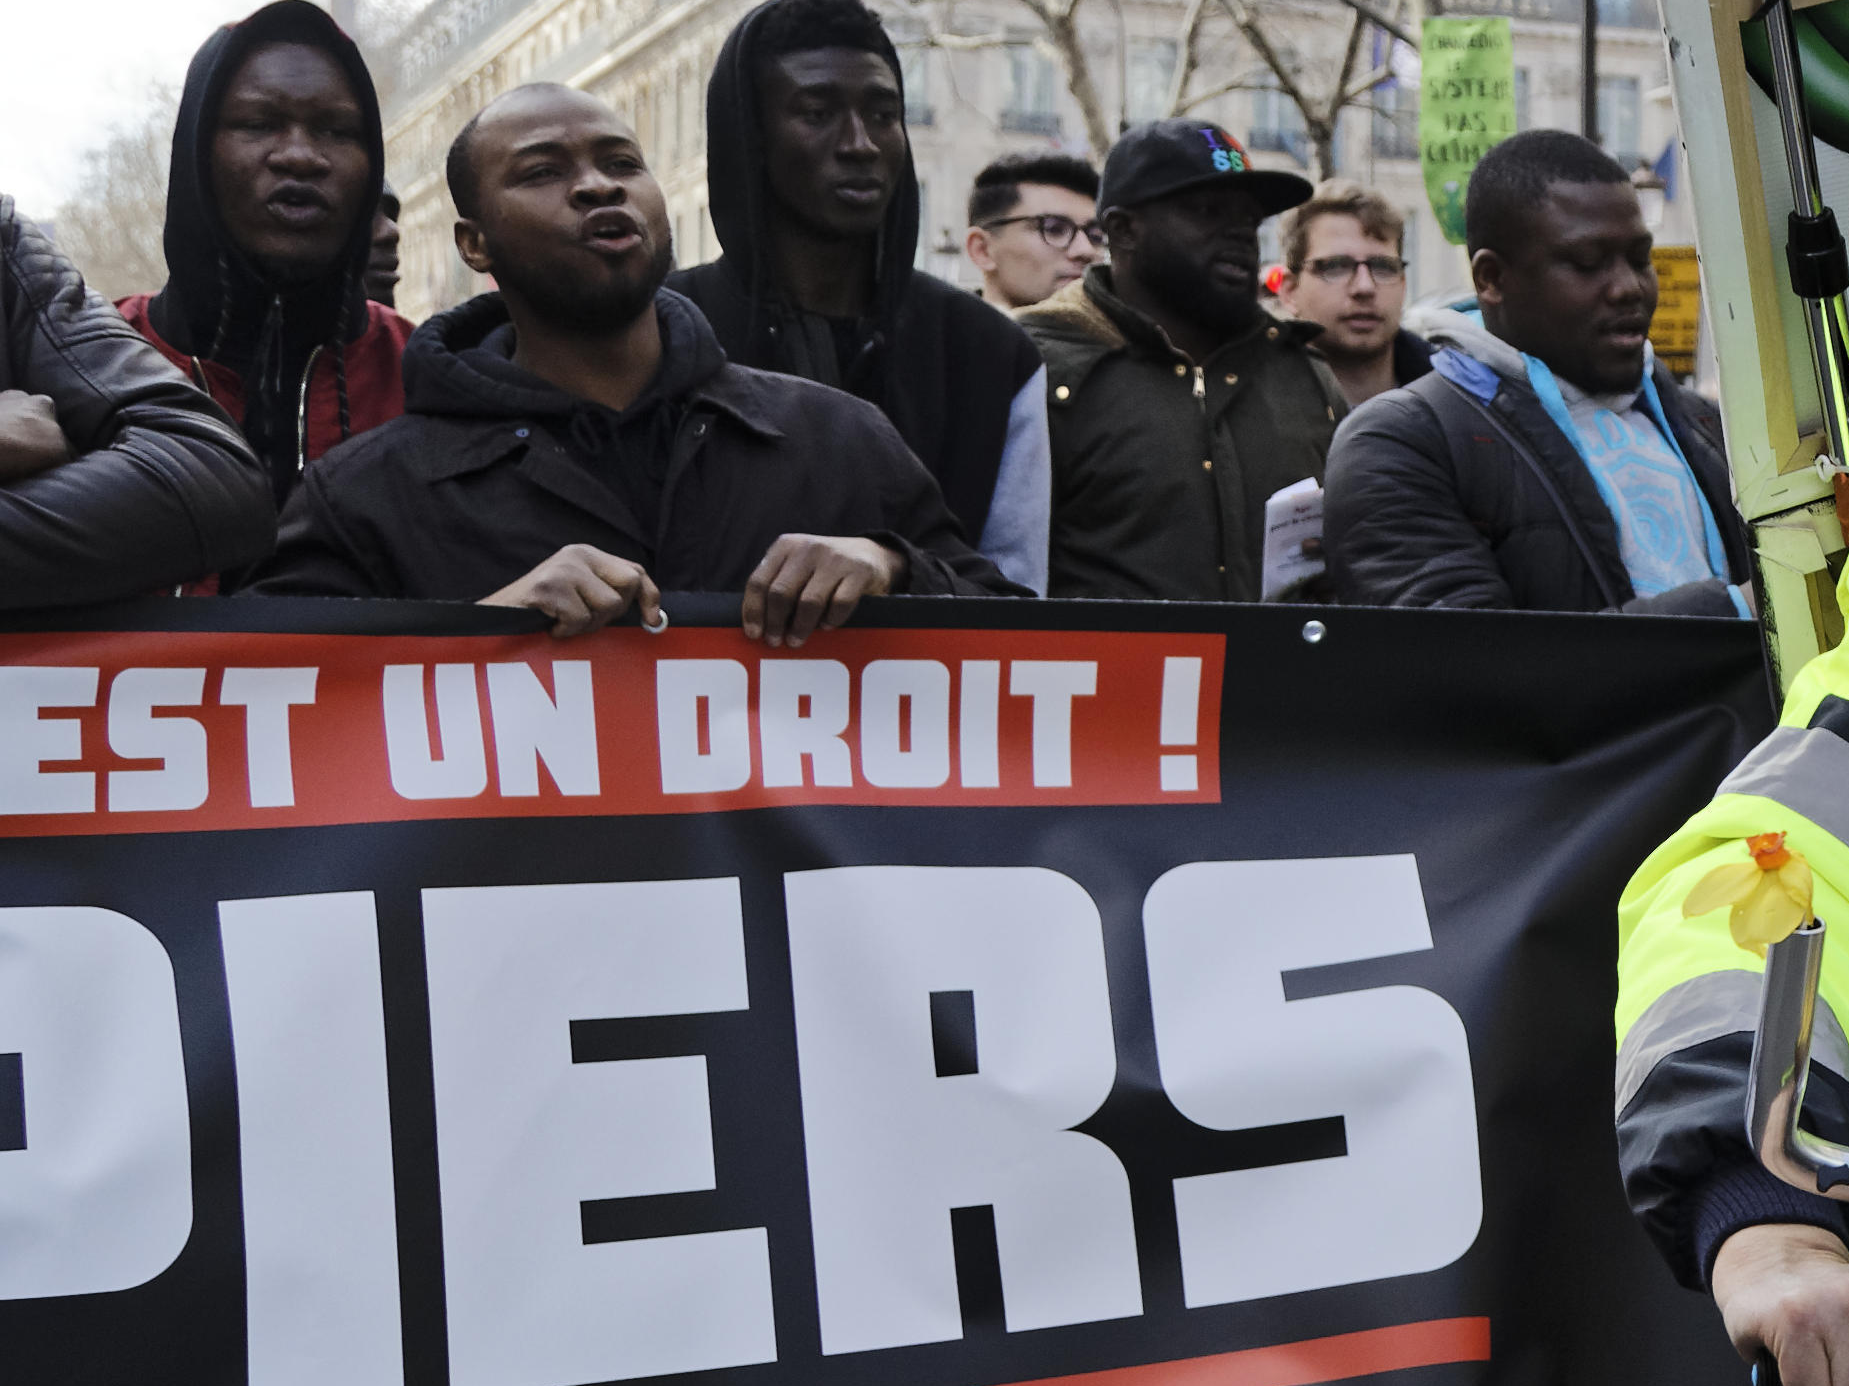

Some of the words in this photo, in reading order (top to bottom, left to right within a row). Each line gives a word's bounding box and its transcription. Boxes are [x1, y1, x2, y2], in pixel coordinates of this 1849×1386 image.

[382, 660, 602, 803] UN
[657, 655, 1097, 800] DROIT
[1157, 655, 1206, 793] !
